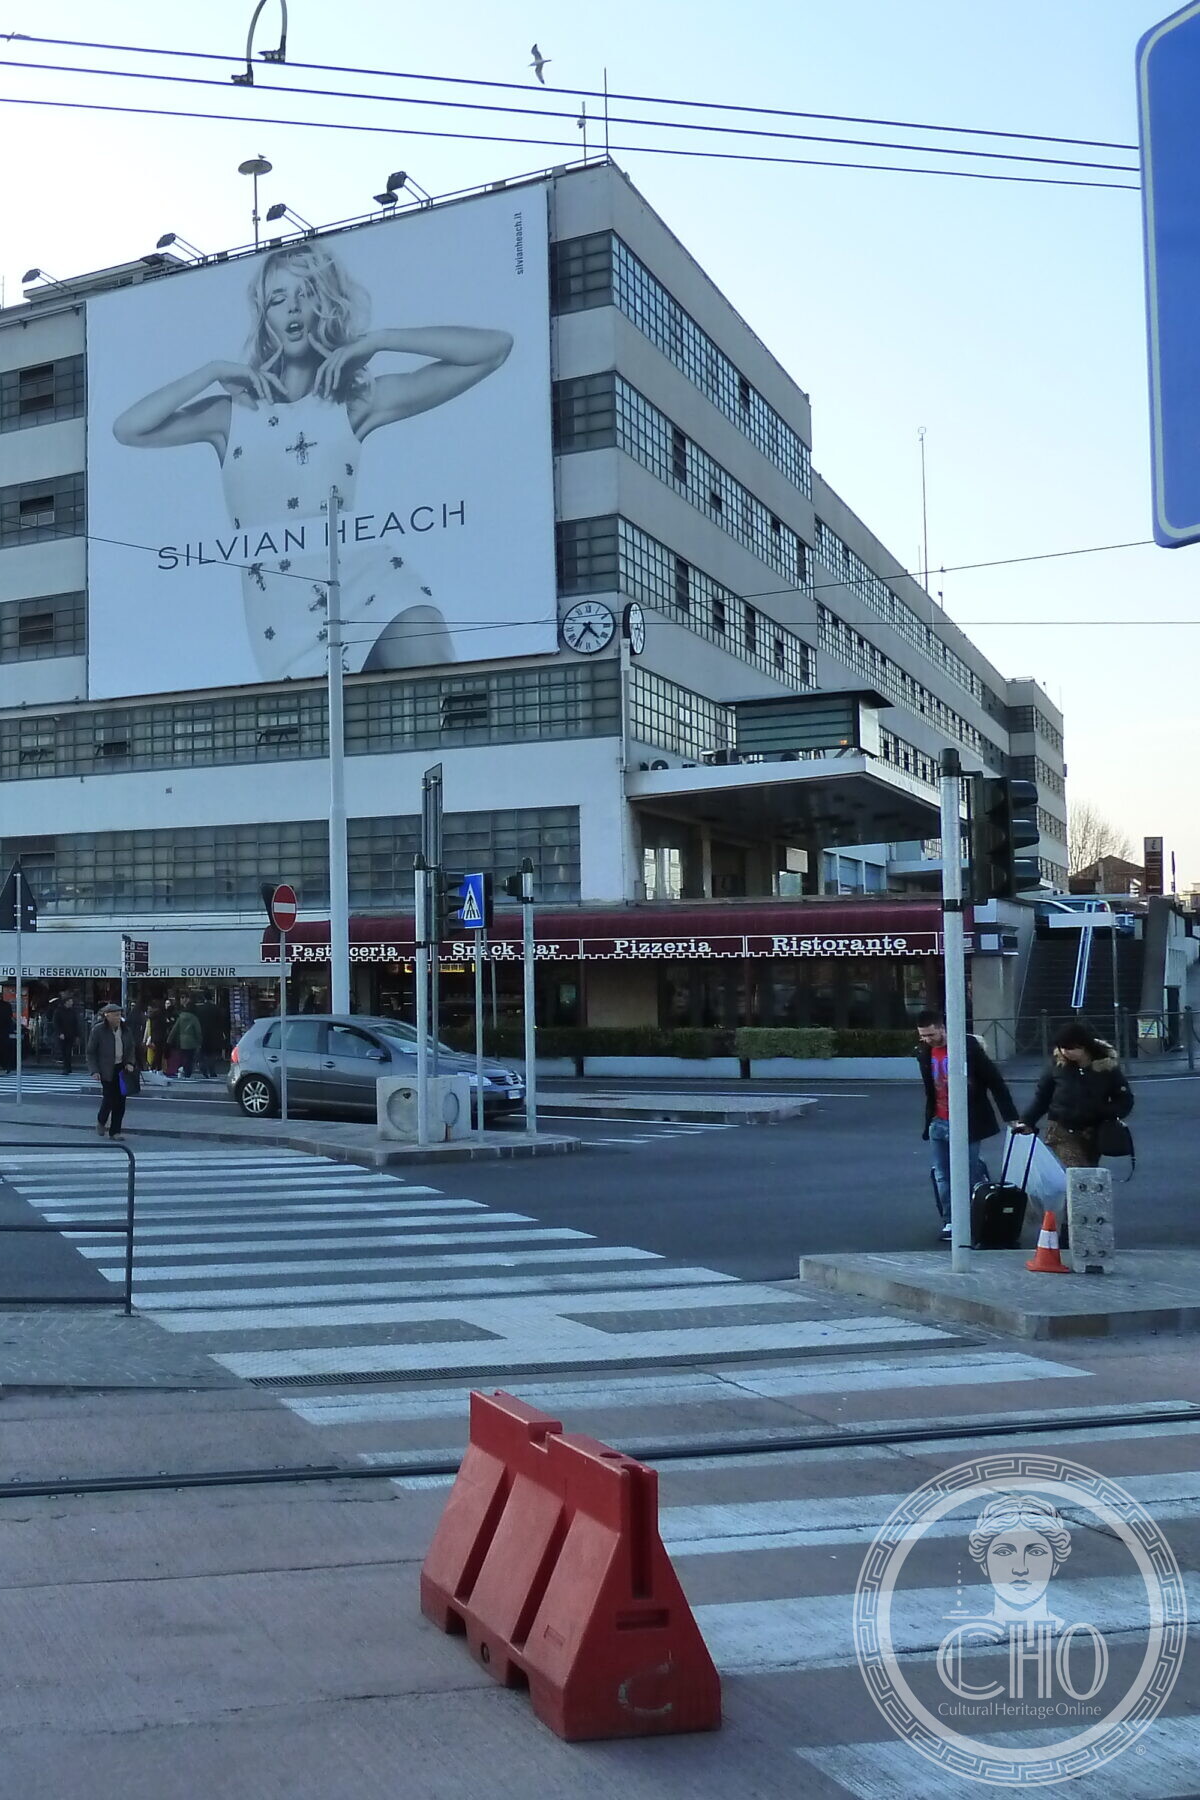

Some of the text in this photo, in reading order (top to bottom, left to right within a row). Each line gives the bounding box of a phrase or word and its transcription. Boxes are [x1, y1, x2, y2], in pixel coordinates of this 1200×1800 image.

[514, 211, 524, 275] silvianheach.it
[157, 500, 465, 570] SILVIAN HEACH
[291, 944, 398, 957] Pastceria
[614, 935, 907, 954] Pizzeria Ristorante
[2, 967, 236, 977] HOEL RESERVATION TBACCHI SOUVENIR
